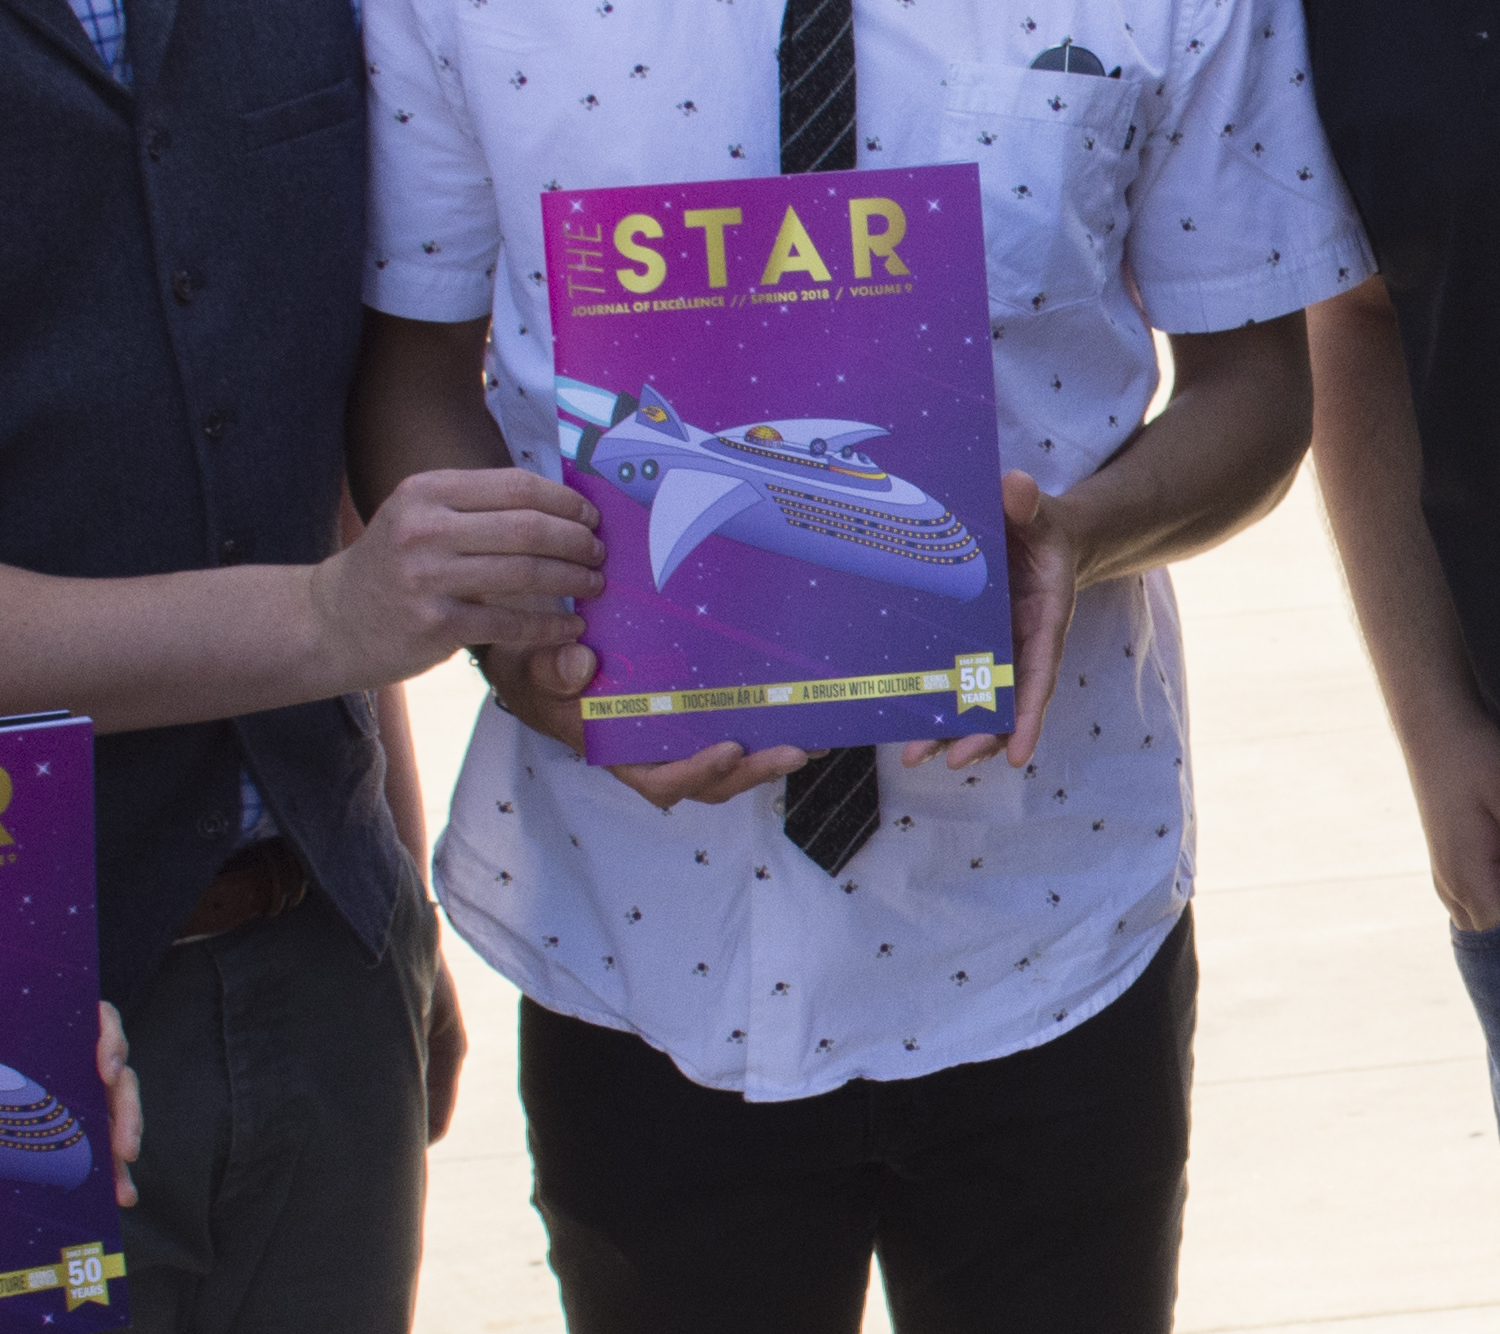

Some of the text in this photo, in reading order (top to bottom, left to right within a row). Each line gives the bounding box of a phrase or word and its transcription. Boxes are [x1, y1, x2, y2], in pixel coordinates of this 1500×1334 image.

[613, 197, 911, 294] STAR
[563, 220, 606, 298] THE
[572, 302, 631, 317] JOURNAL
[633, 300, 650, 313] OF
[653, 295, 724, 311] EXCELLENCE
[751, 290, 798, 305] SPRING
[801, 288, 830, 301] 2018
[849, 283, 902, 298] VOLUME
[904, 282, 914, 294] 9
[803, 685, 810, 700] A
[812, 682, 847, 699] BRUSH
[849, 679, 874, 696] WITH
[878, 676, 921, 694] CULTURE
[960, 666, 992, 691] 50
[589, 701, 613, 716] PINK
[615, 698, 649, 714] CROSS
[961, 691, 992, 704] YEARS
[68, 1257, 102, 1286] 50
[70, 1285, 105, 1299] YEARS
